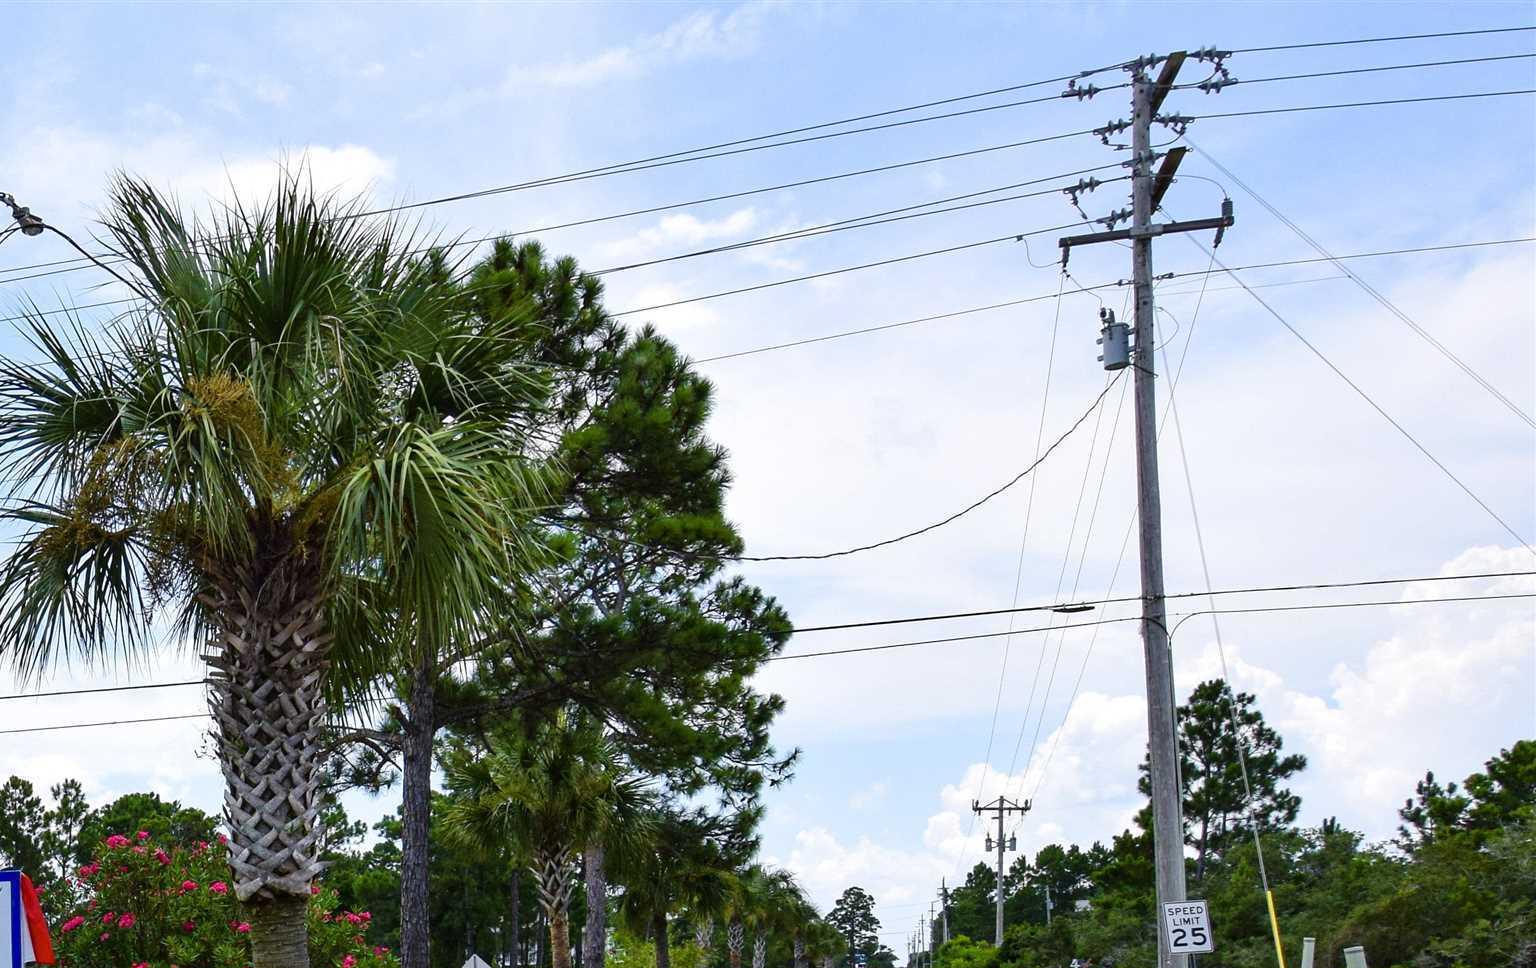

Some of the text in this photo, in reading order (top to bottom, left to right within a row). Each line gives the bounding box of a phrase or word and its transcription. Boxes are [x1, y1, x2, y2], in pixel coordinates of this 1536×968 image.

[1168, 906, 1203, 916] SPEED
[1173, 917, 1200, 926] LIMIT
[1172, 927, 1207, 947] 25
